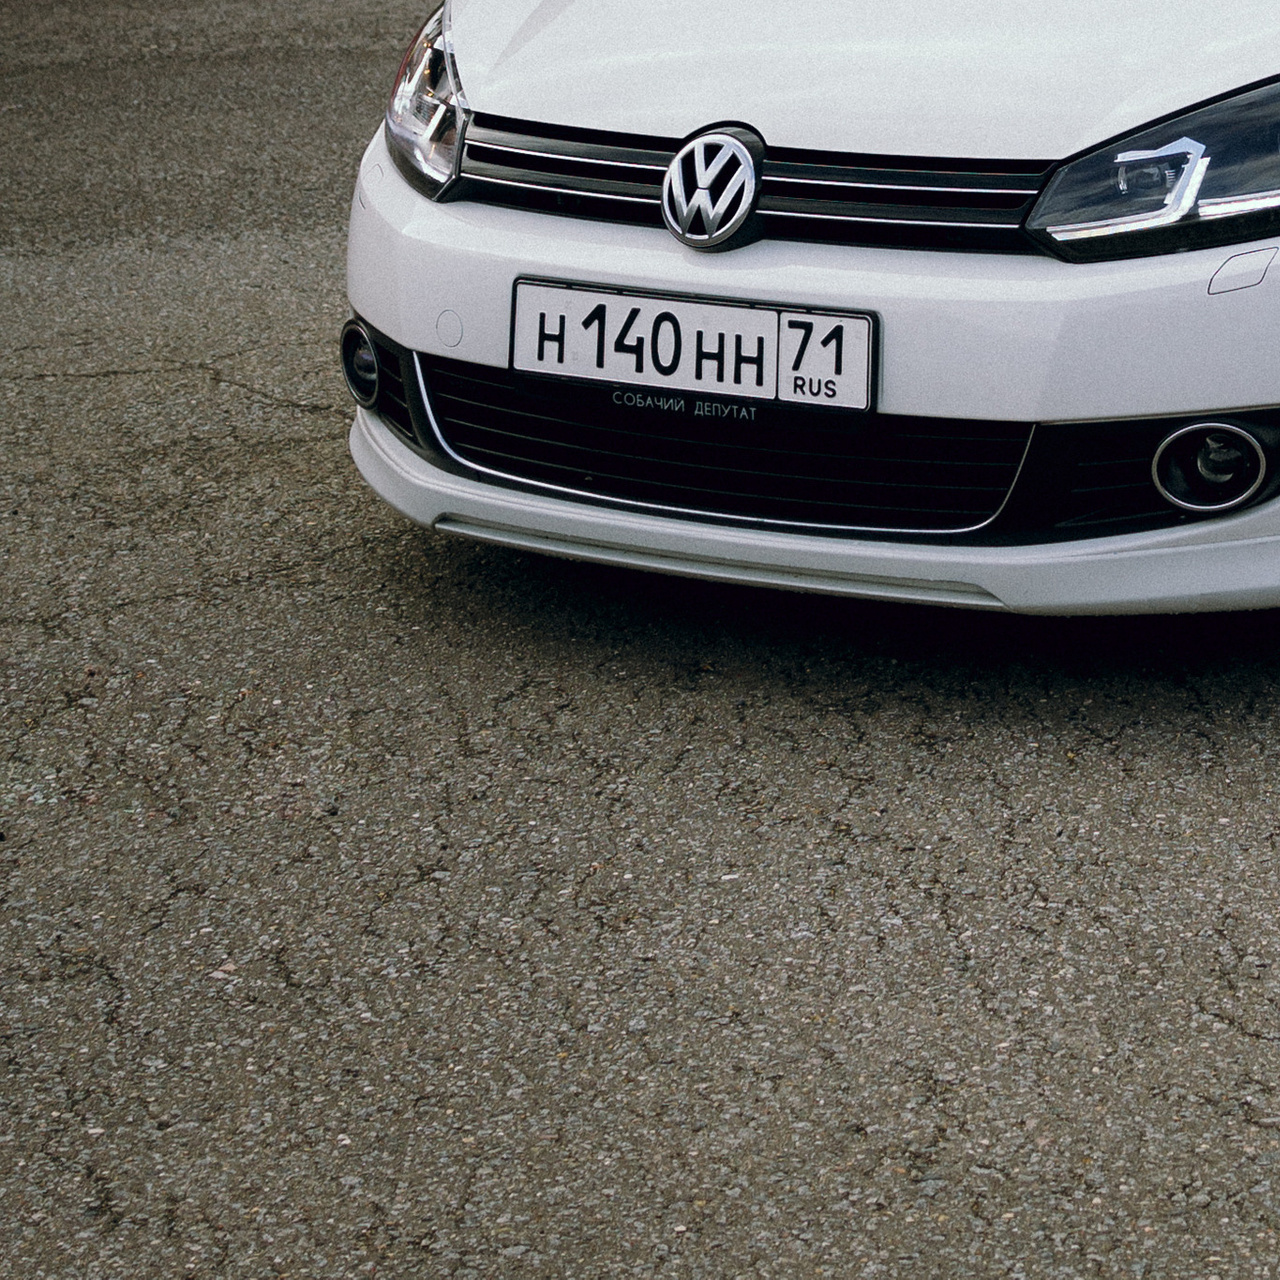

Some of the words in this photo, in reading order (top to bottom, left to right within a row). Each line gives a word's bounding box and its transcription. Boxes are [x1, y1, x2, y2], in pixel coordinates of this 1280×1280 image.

[788, 319, 844, 376] 71
[793, 375, 837, 398] RUS
[612, 391, 685, 413] СОБАЧИЙ
[694, 401, 757, 421] ДЕПУТАТ
